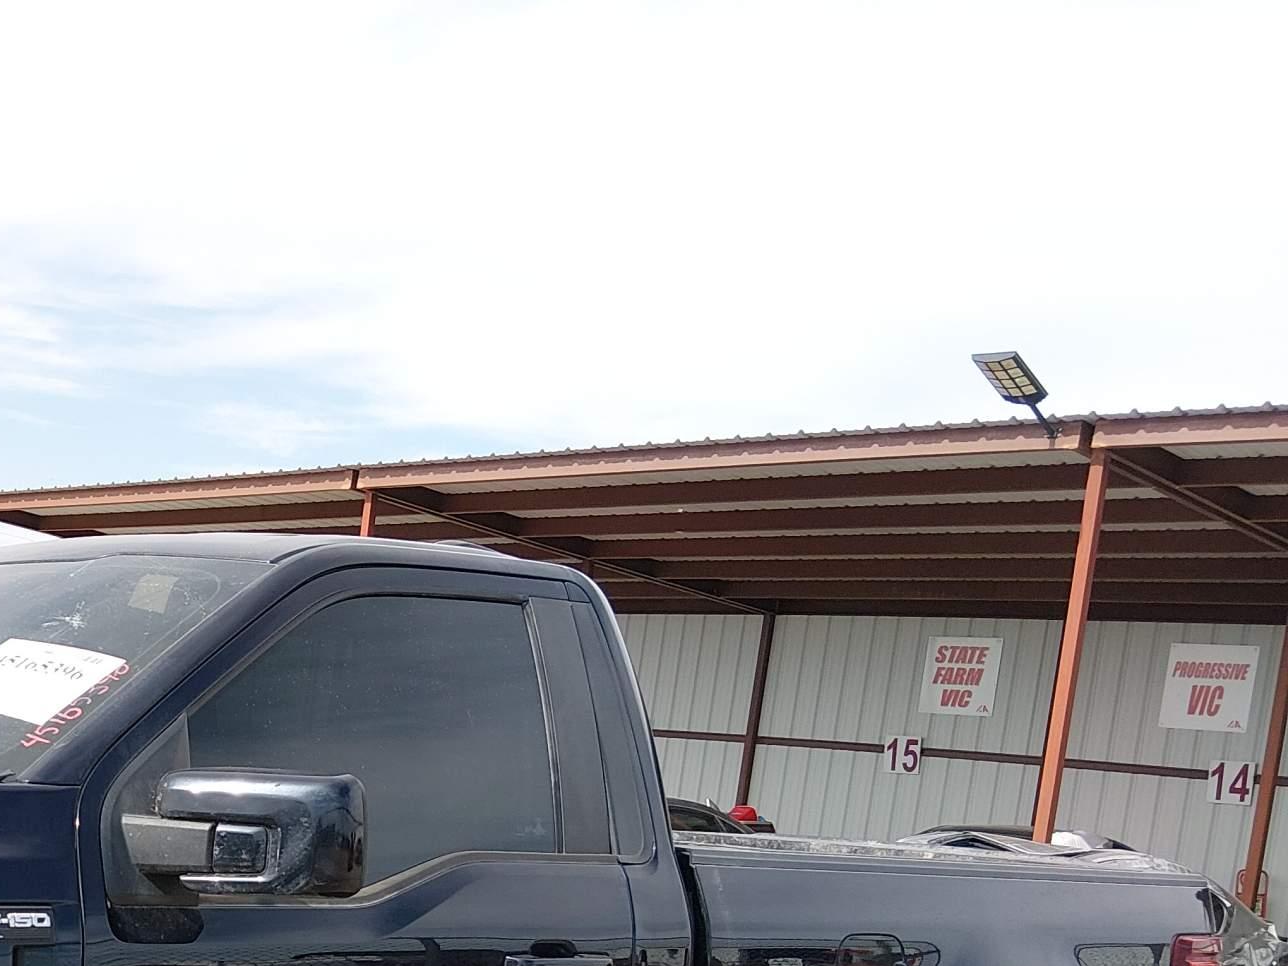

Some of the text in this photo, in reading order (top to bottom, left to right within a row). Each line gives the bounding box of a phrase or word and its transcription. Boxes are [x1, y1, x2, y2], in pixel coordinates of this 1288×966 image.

[935, 645, 990, 664] STATE
[932, 666, 984, 686] FARM
[1172, 661, 1250, 681] PROGRESSIVE
[940, 689, 973, 708] VIC
[1187, 684, 1225, 717] VIC
[886, 737, 919, 773] 15
[1211, 762, 1250, 802] 14
